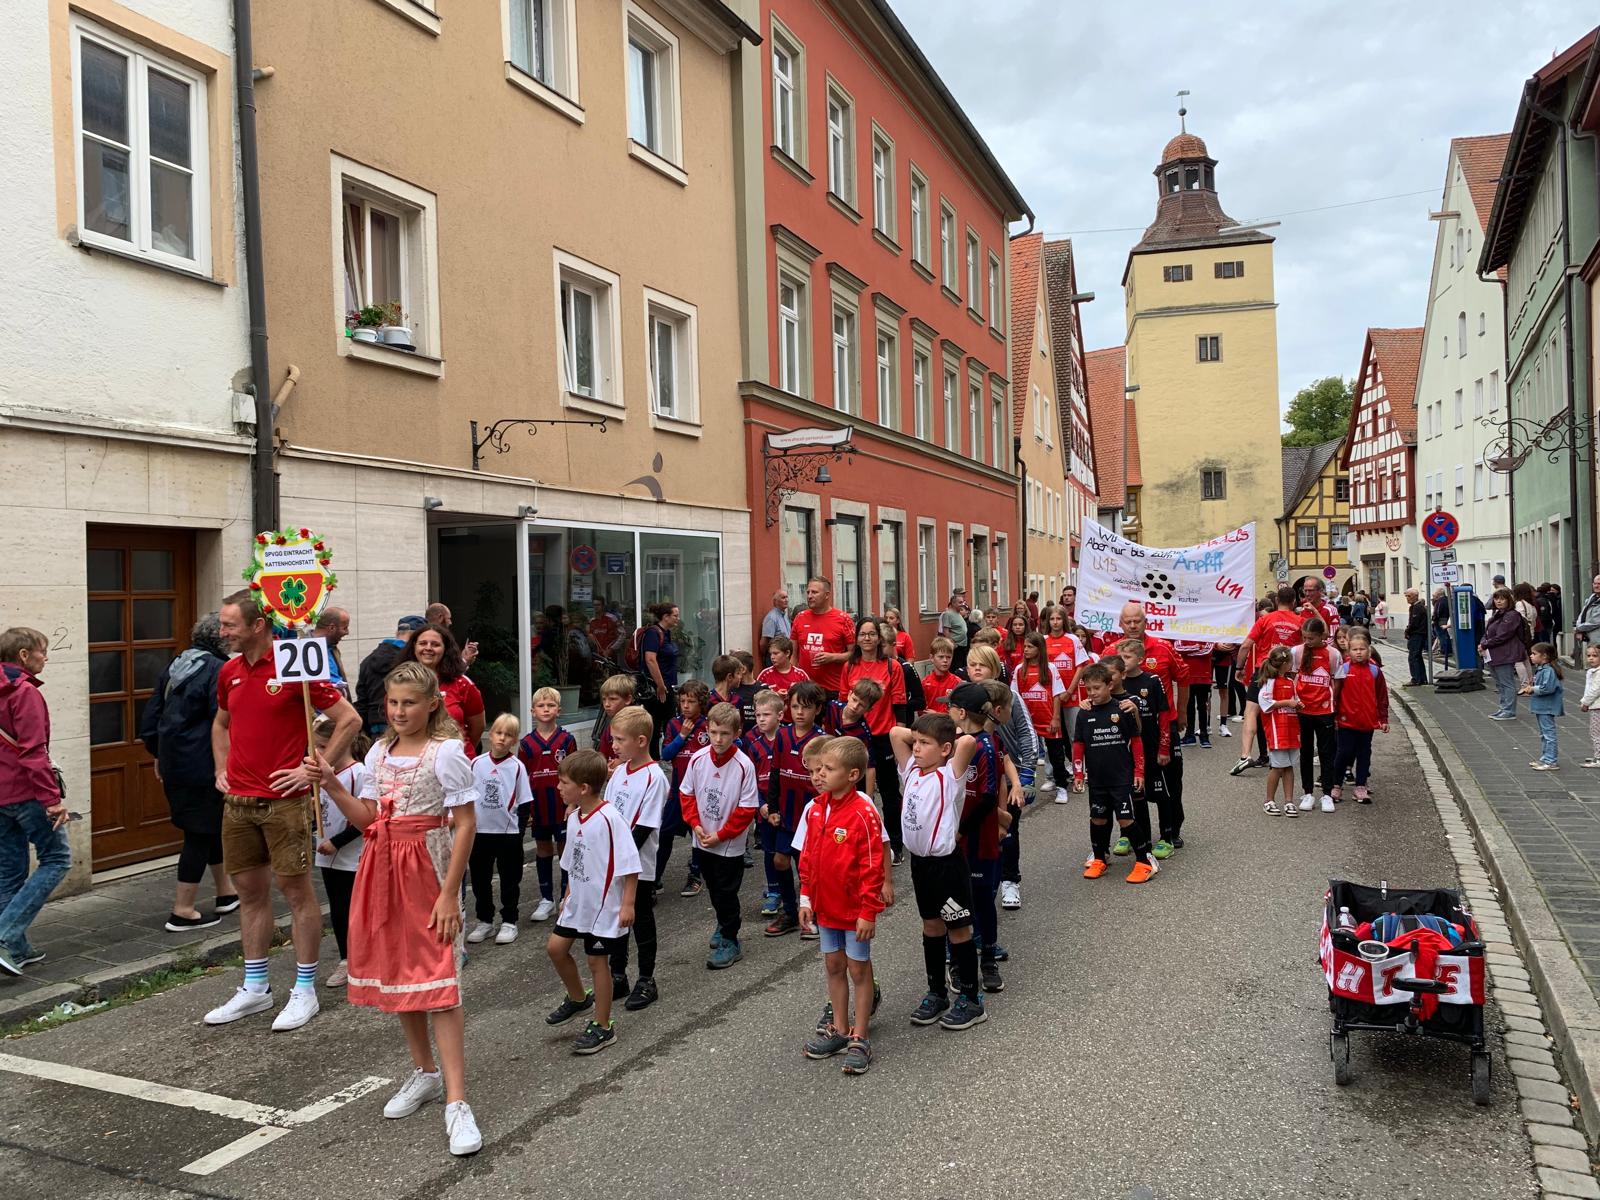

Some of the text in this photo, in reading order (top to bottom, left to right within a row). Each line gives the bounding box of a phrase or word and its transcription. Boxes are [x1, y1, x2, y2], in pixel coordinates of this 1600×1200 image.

[265, 559, 315, 567] KATTENHOCHSTATT
[284, 549, 313, 557] EINTRACHT
[1086, 537, 1108, 551] Aber
[1111, 546, 1126, 555] nur
[1131, 547, 1145, 558] bis
[1173, 551, 1224, 573] Anpfiff
[1093, 555, 1118, 573] U15
[1081, 609, 1114, 631] SpVgg
[51, 626, 72, 651] 2
[279, 641, 324, 677] 20
